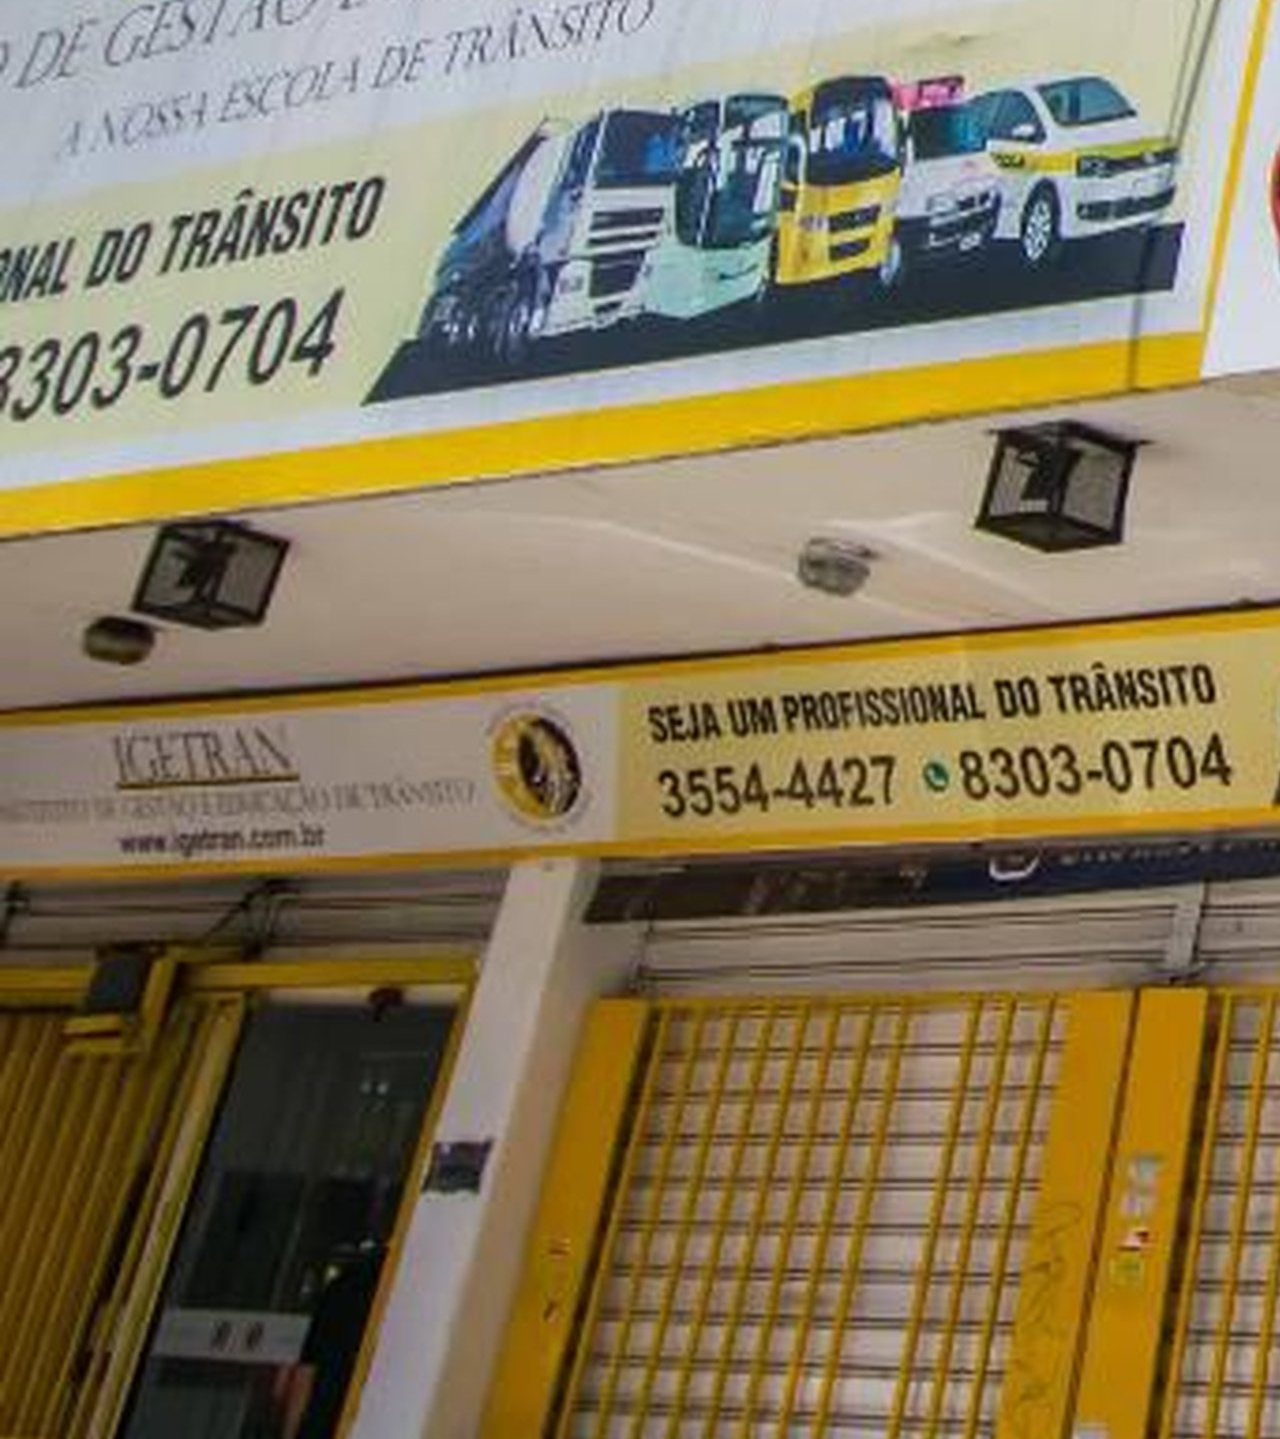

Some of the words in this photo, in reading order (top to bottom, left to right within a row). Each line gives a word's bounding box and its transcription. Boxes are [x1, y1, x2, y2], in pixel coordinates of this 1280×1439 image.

[14, 19, 99, 90] DE
[86, 90, 210, 153] NOSSA
[218, 55, 360, 124] ESCOLA
[372, 39, 427, 90] DE
[84, 221, 153, 290] DO
[156, 175, 387, 277] TRÂNSITO
[647, 704, 722, 744] SEJA
[730, 697, 780, 738] UM
[782, 682, 986, 734] PROFISSIONAL
[995, 678, 1041, 719] DO
[1052, 661, 1217, 714] TRÂNSITO
[112, 725, 294, 783] IGETRAN
[657, 754, 898, 818] 3554-4427
[958, 733, 1232, 803] 8303-0704
